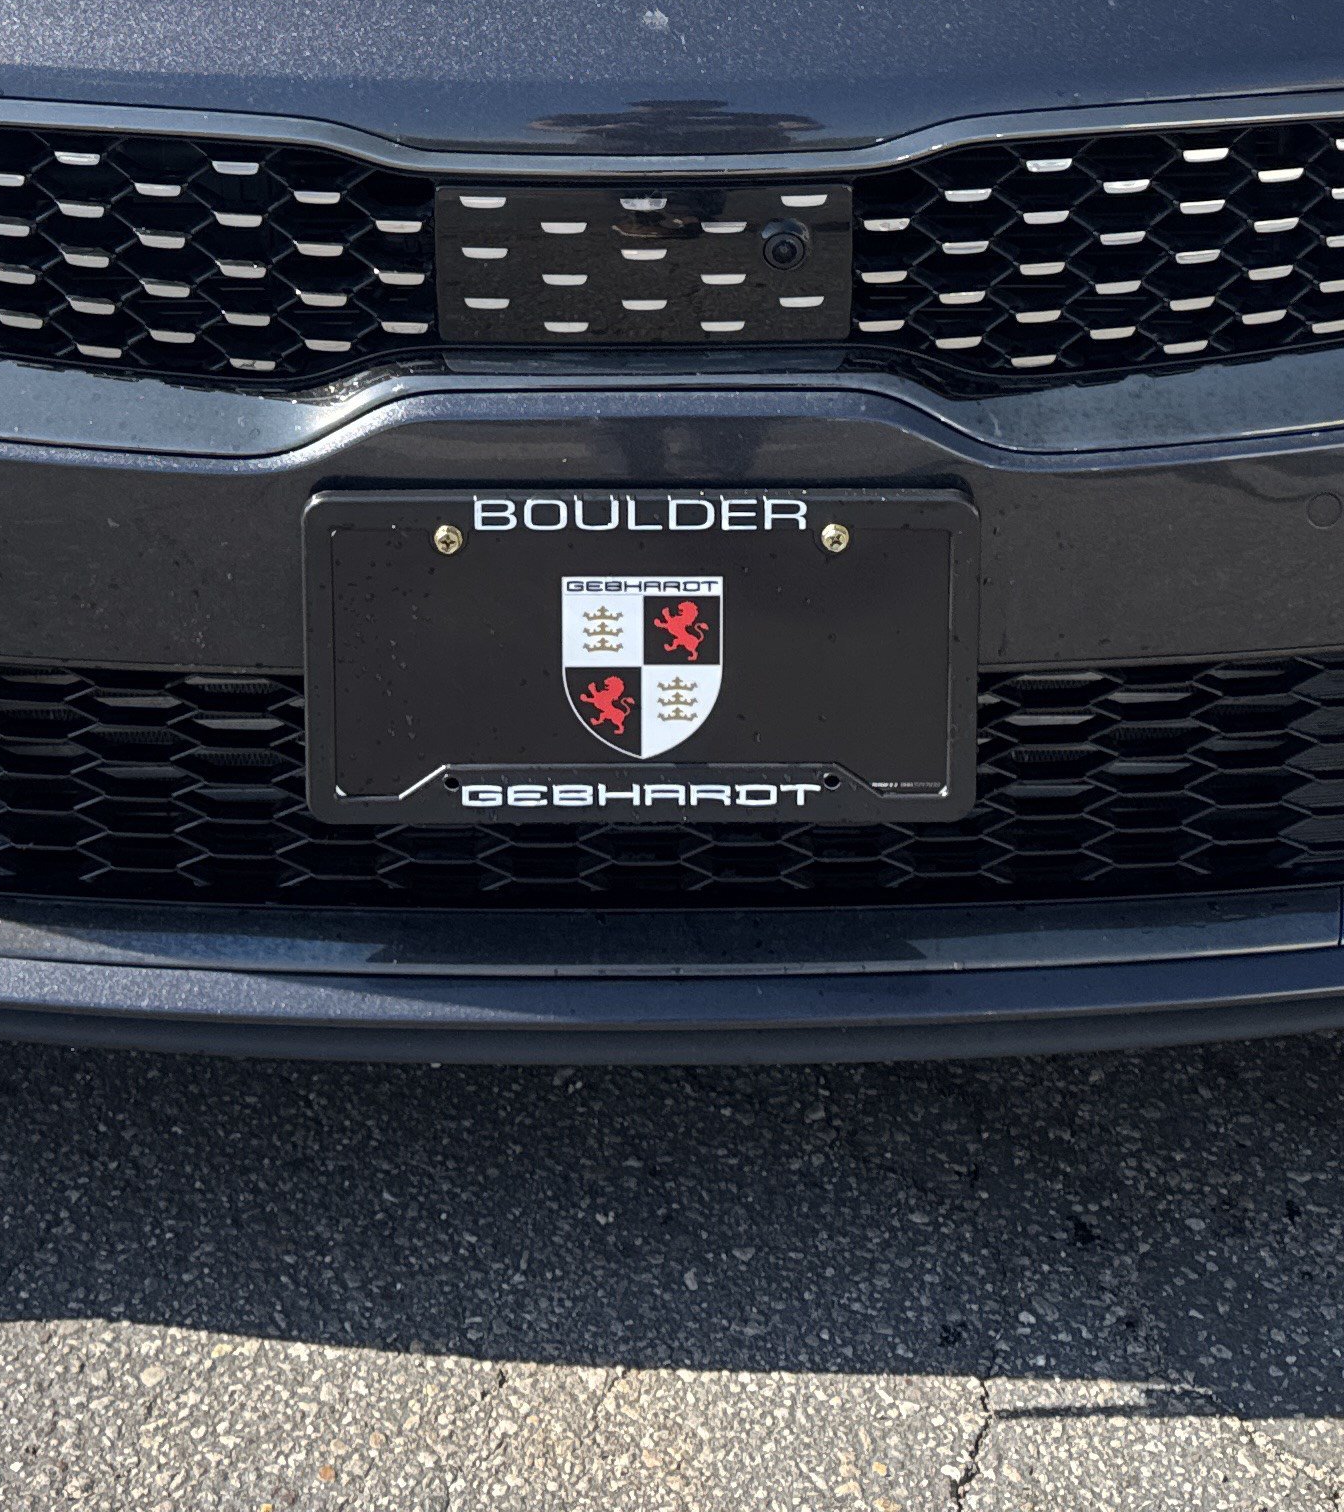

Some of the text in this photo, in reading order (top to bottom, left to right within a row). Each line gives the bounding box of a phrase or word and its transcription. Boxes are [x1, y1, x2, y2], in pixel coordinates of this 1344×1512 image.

[472, 494, 808, 531] BOULDER
[566, 580, 720, 594] GEBHARDT
[461, 782, 822, 807] GEBHARDT
